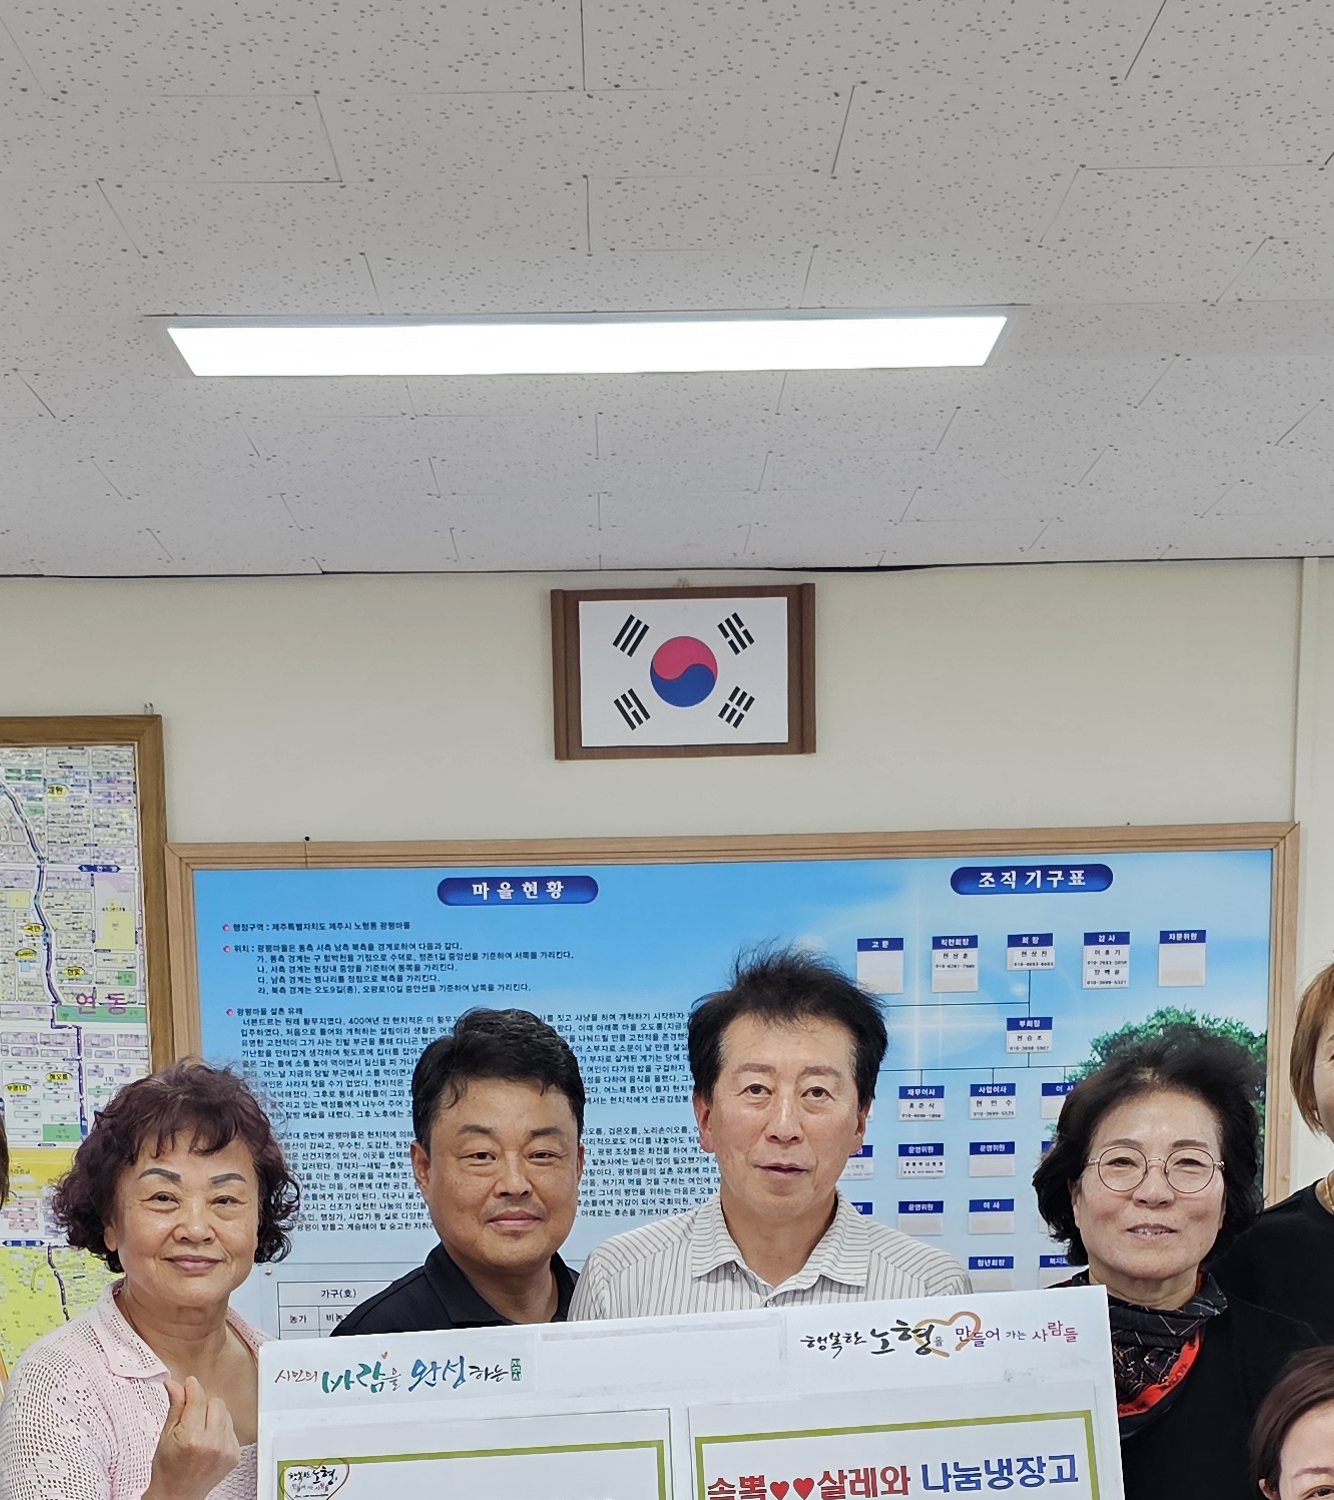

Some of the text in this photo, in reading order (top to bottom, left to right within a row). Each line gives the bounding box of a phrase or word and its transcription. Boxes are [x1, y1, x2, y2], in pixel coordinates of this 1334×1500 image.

[472, 881, 564, 900] 마을현황
[321, 1289, 357, 1299] 가구(호)
[800, 1331, 867, 1359] 행복한
[955, 1325, 1000, 1348] 만들어
[1006, 1331, 1027, 1341] 가는
[1032, 1320, 1079, 1344] 사람들
[275, 1369, 318, 1384] 시민의
[322, 1360, 402, 1393] 바람을
[408, 1355, 509, 1392] 완성하는
[921, 1453, 1079, 1493] 나눔냉장고
